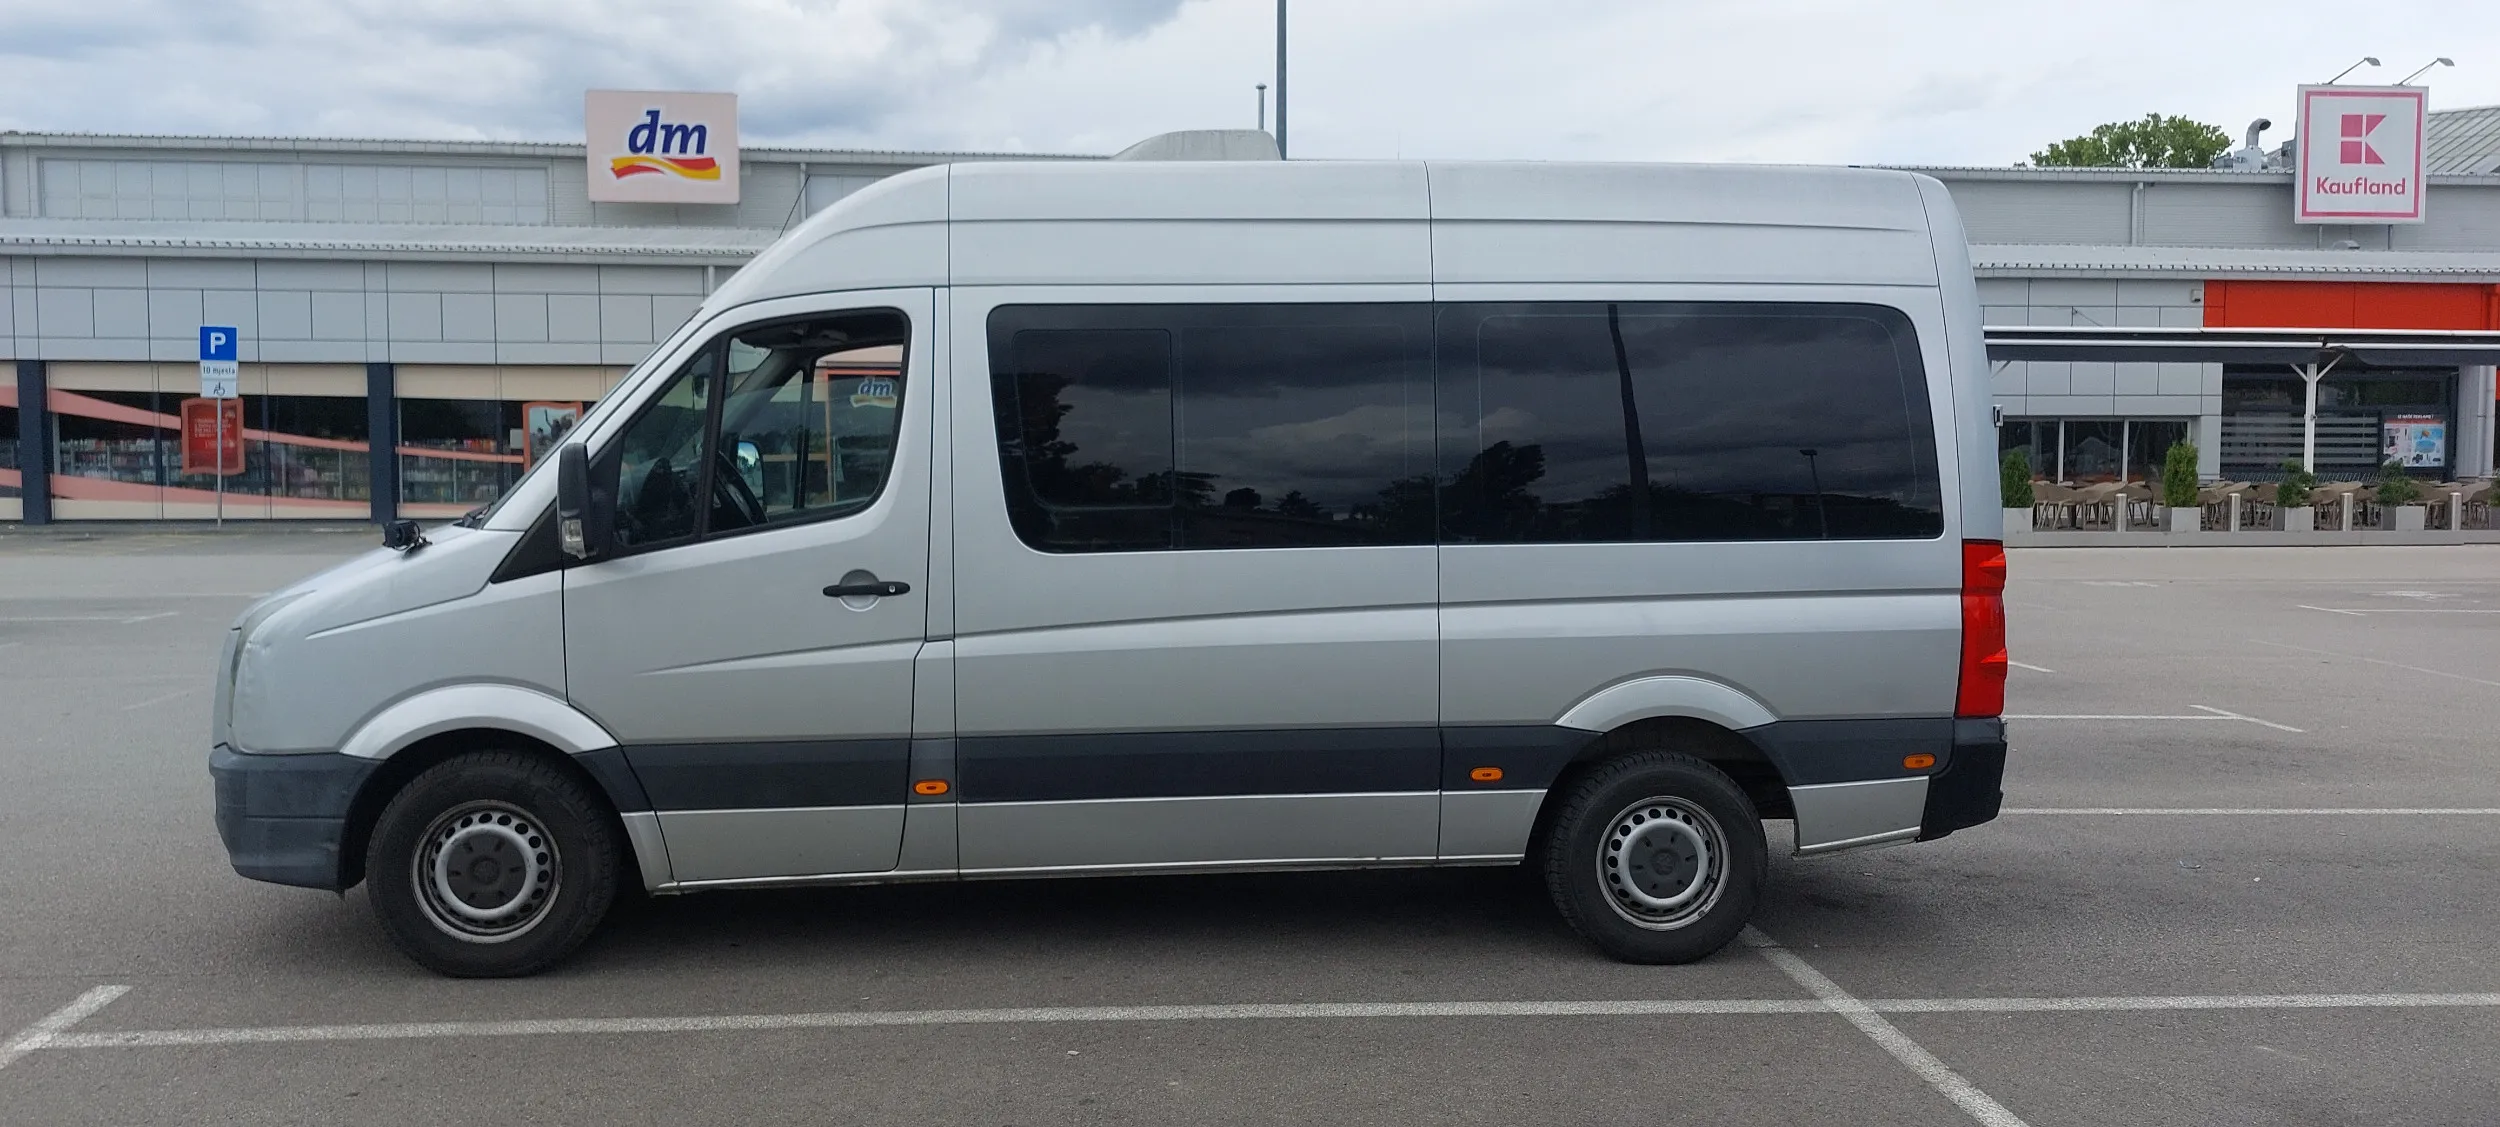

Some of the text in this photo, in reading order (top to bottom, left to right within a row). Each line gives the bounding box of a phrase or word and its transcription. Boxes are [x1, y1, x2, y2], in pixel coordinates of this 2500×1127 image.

[628, 110, 707, 154] dm
[2316, 176, 2406, 195] Kaufland
[210, 332, 226, 354] P
[859, 377, 892, 396] dm
